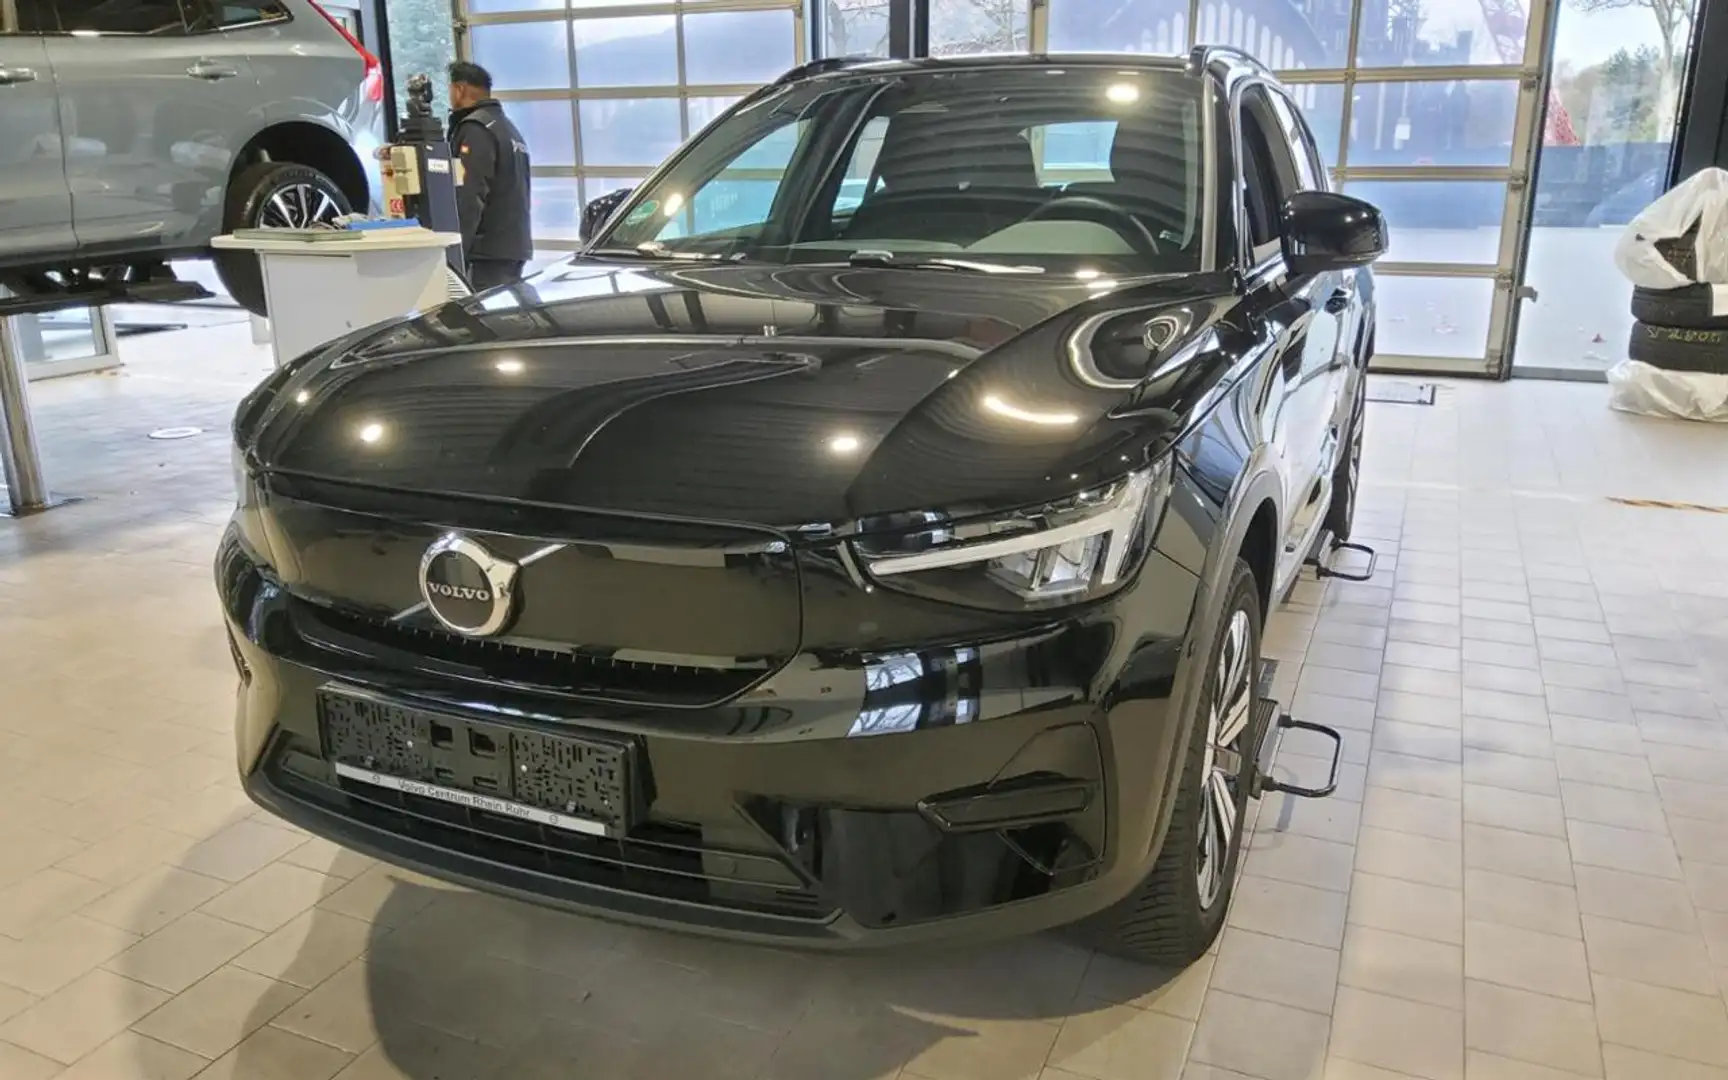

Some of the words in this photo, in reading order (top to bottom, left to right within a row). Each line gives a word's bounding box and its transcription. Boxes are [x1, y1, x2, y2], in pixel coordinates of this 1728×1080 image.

[427, 581, 491, 601] VOLVO
[398, 778, 425, 795] Volvo
[428, 786, 471, 804] Centrum
[472, 795, 503, 811] Rhein
[505, 802, 531, 817] Ruhr
